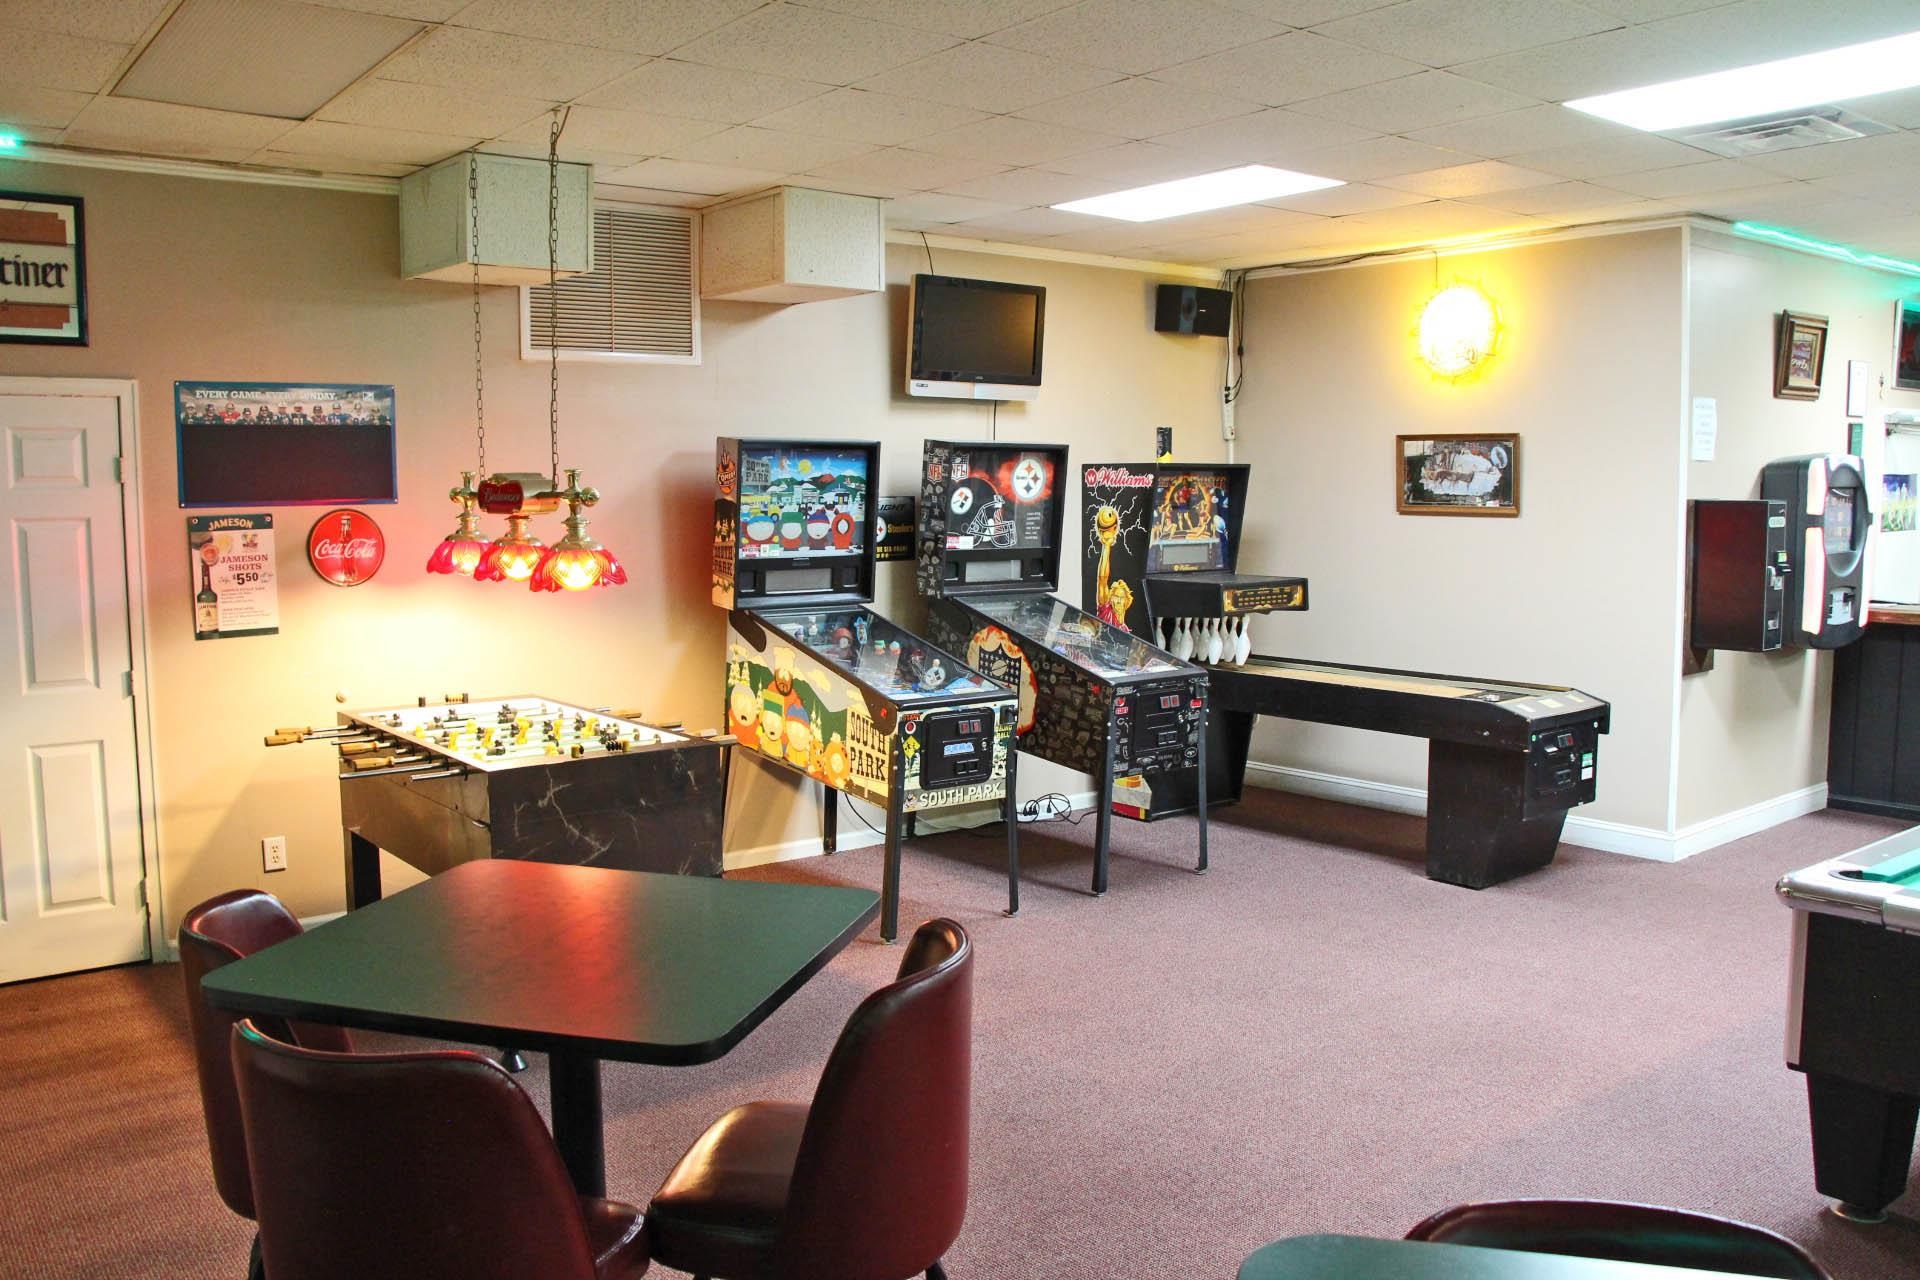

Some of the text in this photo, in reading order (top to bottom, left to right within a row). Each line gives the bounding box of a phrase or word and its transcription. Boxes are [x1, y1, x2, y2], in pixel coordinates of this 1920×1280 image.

[195, 390, 228, 399] EVERY
[301, 392, 338, 401] UNDAY.
[745, 471, 769, 483] PARK
[951, 464, 968, 478] NFL
[1098, 467, 1153, 487] Williams
[208, 518, 254, 531] JAMESON
[220, 554, 268, 564] JAMESON
[228, 563, 262, 572] SHOTS
[714, 559, 733, 576] PARK
[850, 711, 887, 755] SOUTH
[850, 746, 886, 782] PARK
[919, 782, 1001, 807] SOUTH PARK
